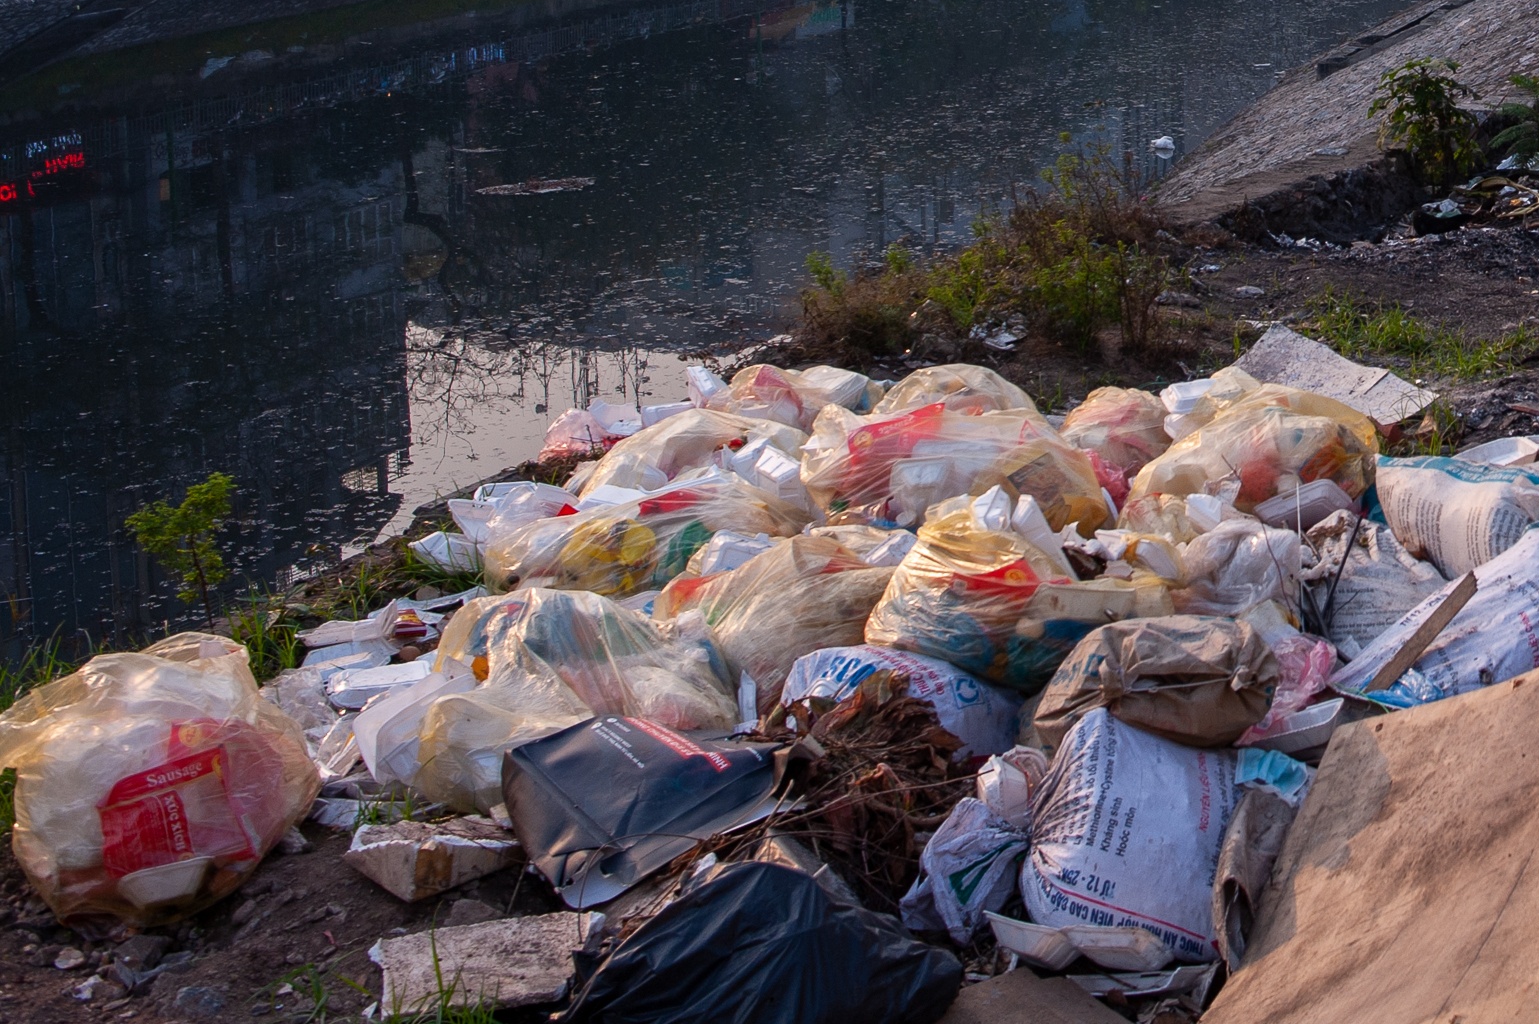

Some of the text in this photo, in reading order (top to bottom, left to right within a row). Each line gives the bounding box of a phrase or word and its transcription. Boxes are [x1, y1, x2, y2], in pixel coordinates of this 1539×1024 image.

[146, 761, 203, 788] Sausage
[1099, 796, 1123, 853] Kháng sinh
[1115, 828, 1132, 857] Hoóc
[1086, 874, 1100, 892] 12
[1069, 902, 1089, 920] CAO
